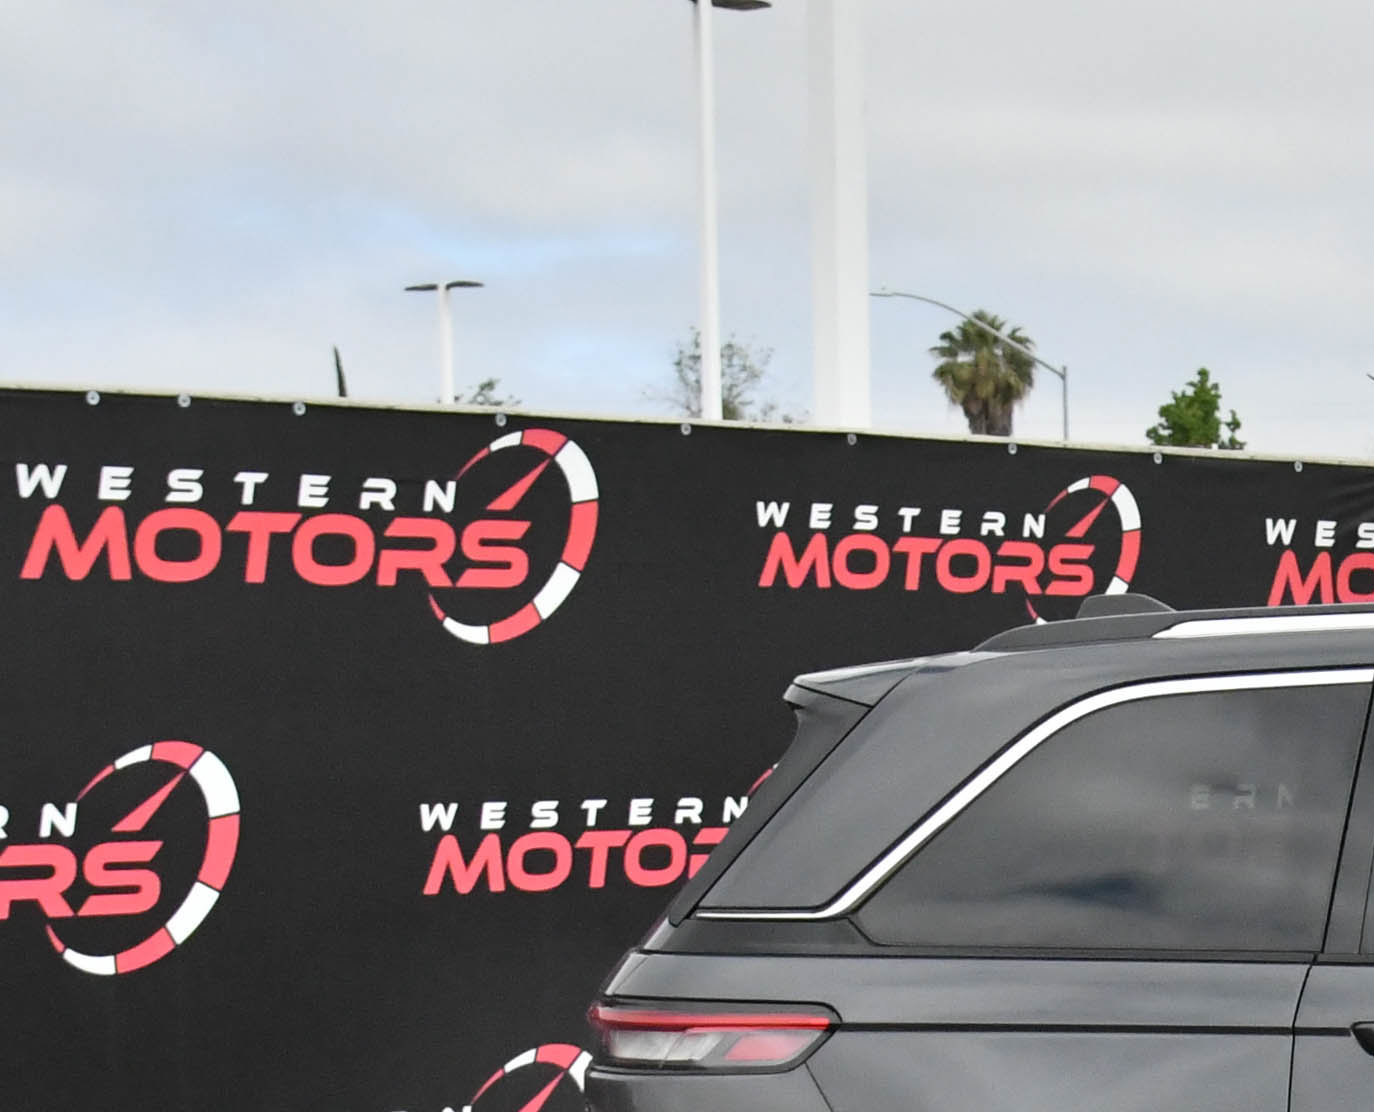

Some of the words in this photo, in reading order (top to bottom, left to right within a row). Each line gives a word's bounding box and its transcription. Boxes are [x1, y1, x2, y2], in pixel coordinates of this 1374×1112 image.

[16, 463, 457, 512] WESTERN
[757, 501, 1046, 539] WESTERN
[20, 503, 532, 589] MOTORS
[759, 531, 1095, 596] MOTORS
[419, 796, 749, 832] WESTERN
